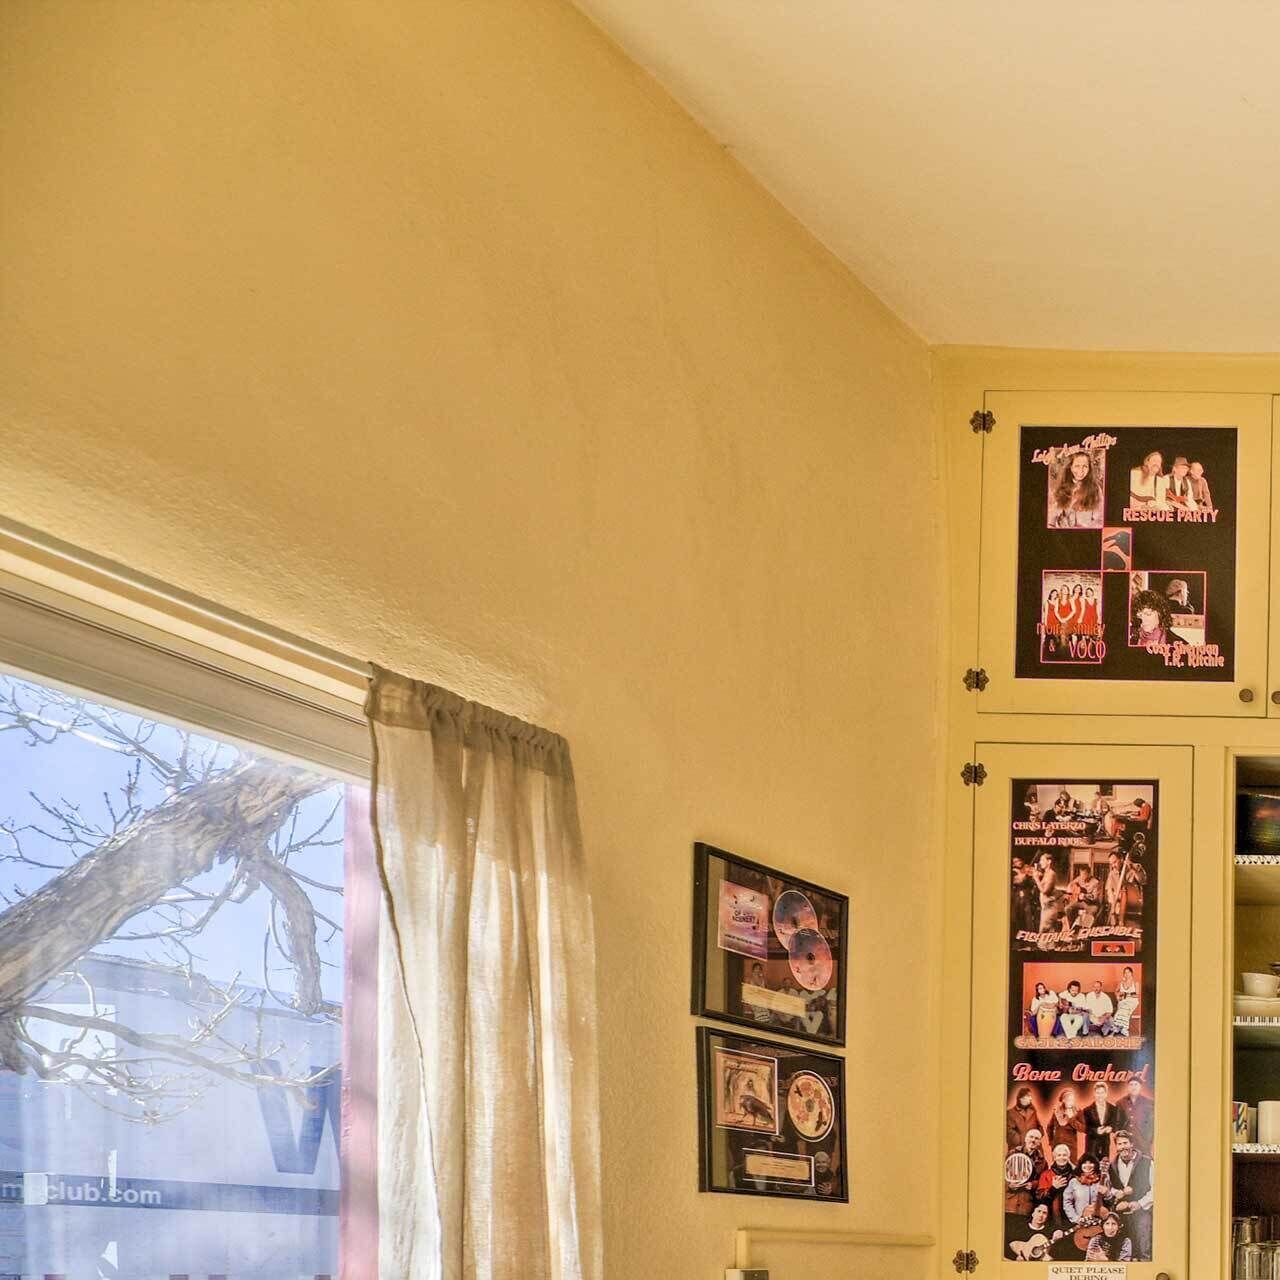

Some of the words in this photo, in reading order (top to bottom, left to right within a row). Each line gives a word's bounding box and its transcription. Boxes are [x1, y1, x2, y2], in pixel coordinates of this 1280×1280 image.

[1123, 508, 1173, 522] RESCUE
[1177, 508, 1219, 523] PARTY
[1069, 640, 1106, 659] VOCO
[1013, 1063, 1061, 1081] Bone
[1072, 1063, 1149, 1082] Orchard
